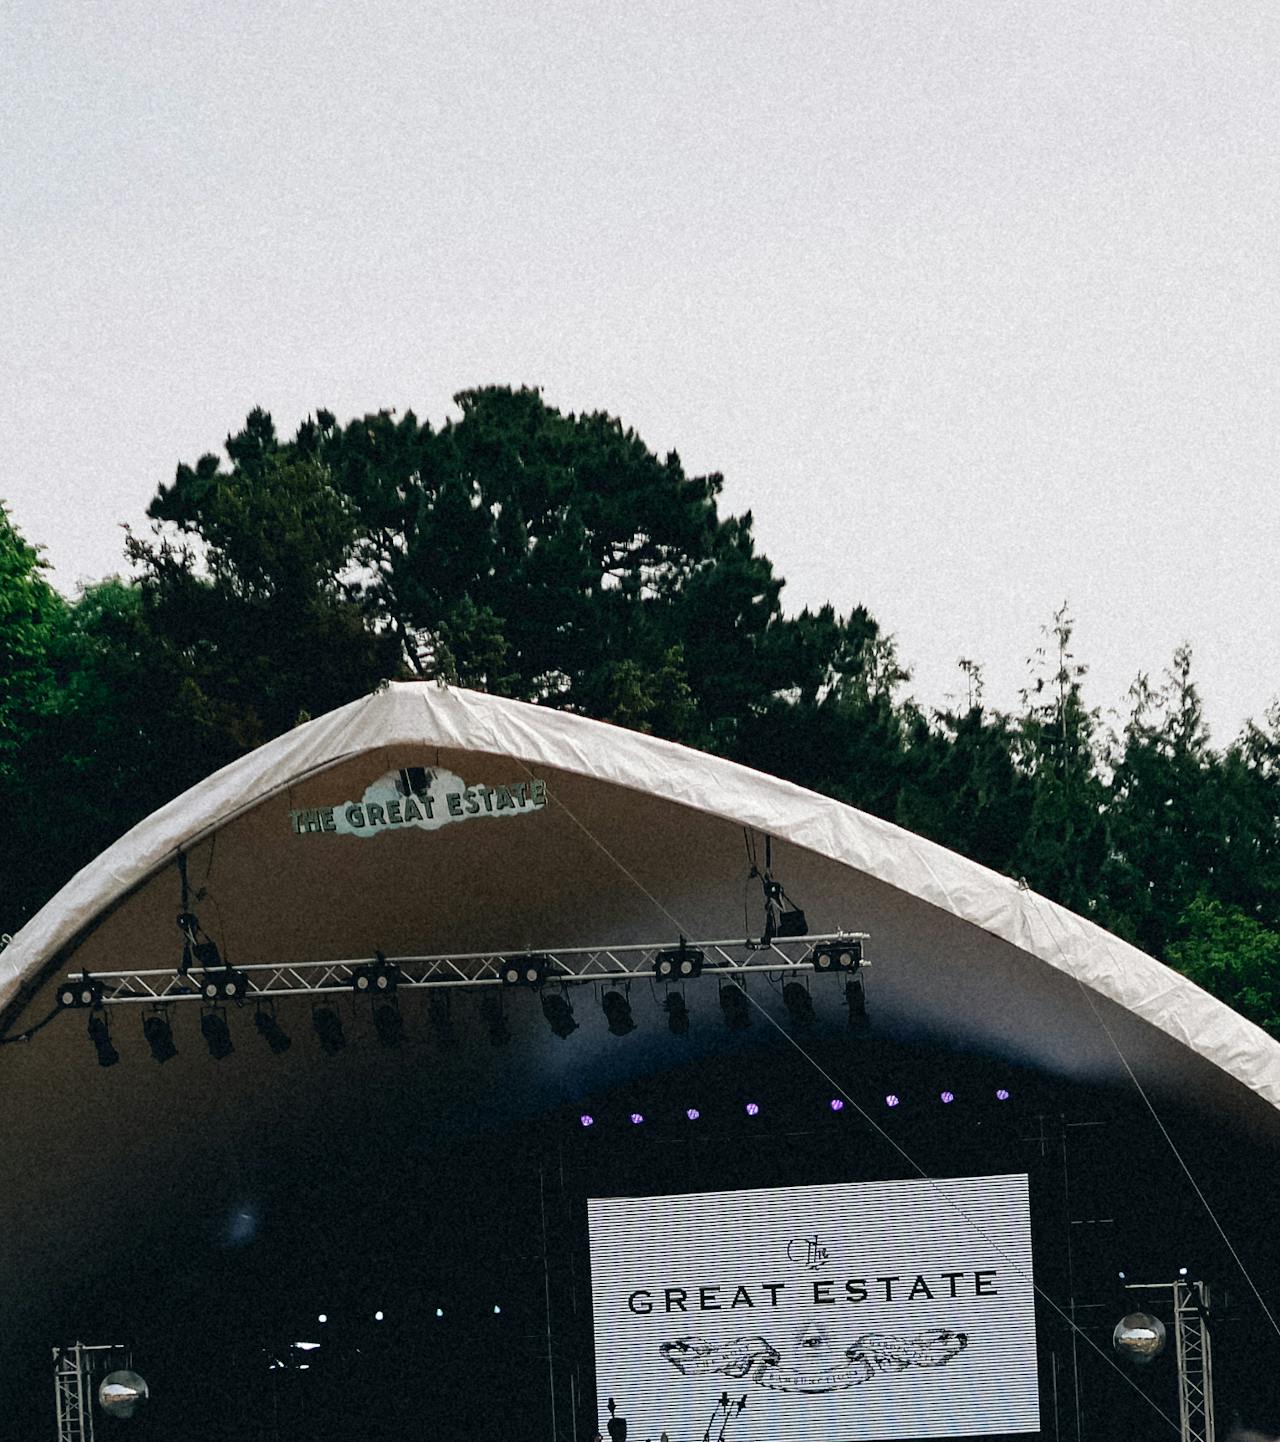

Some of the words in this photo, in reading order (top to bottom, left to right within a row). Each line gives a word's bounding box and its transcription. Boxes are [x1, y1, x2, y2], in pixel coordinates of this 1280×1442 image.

[289, 807, 337, 834] THE
[345, 796, 435, 829] GREAT
[446, 779, 548, 816] ESTATE
[786, 1235, 829, 1270] The
[628, 1283, 786, 1315] GREAT
[812, 1270, 998, 1304] ESTATE
